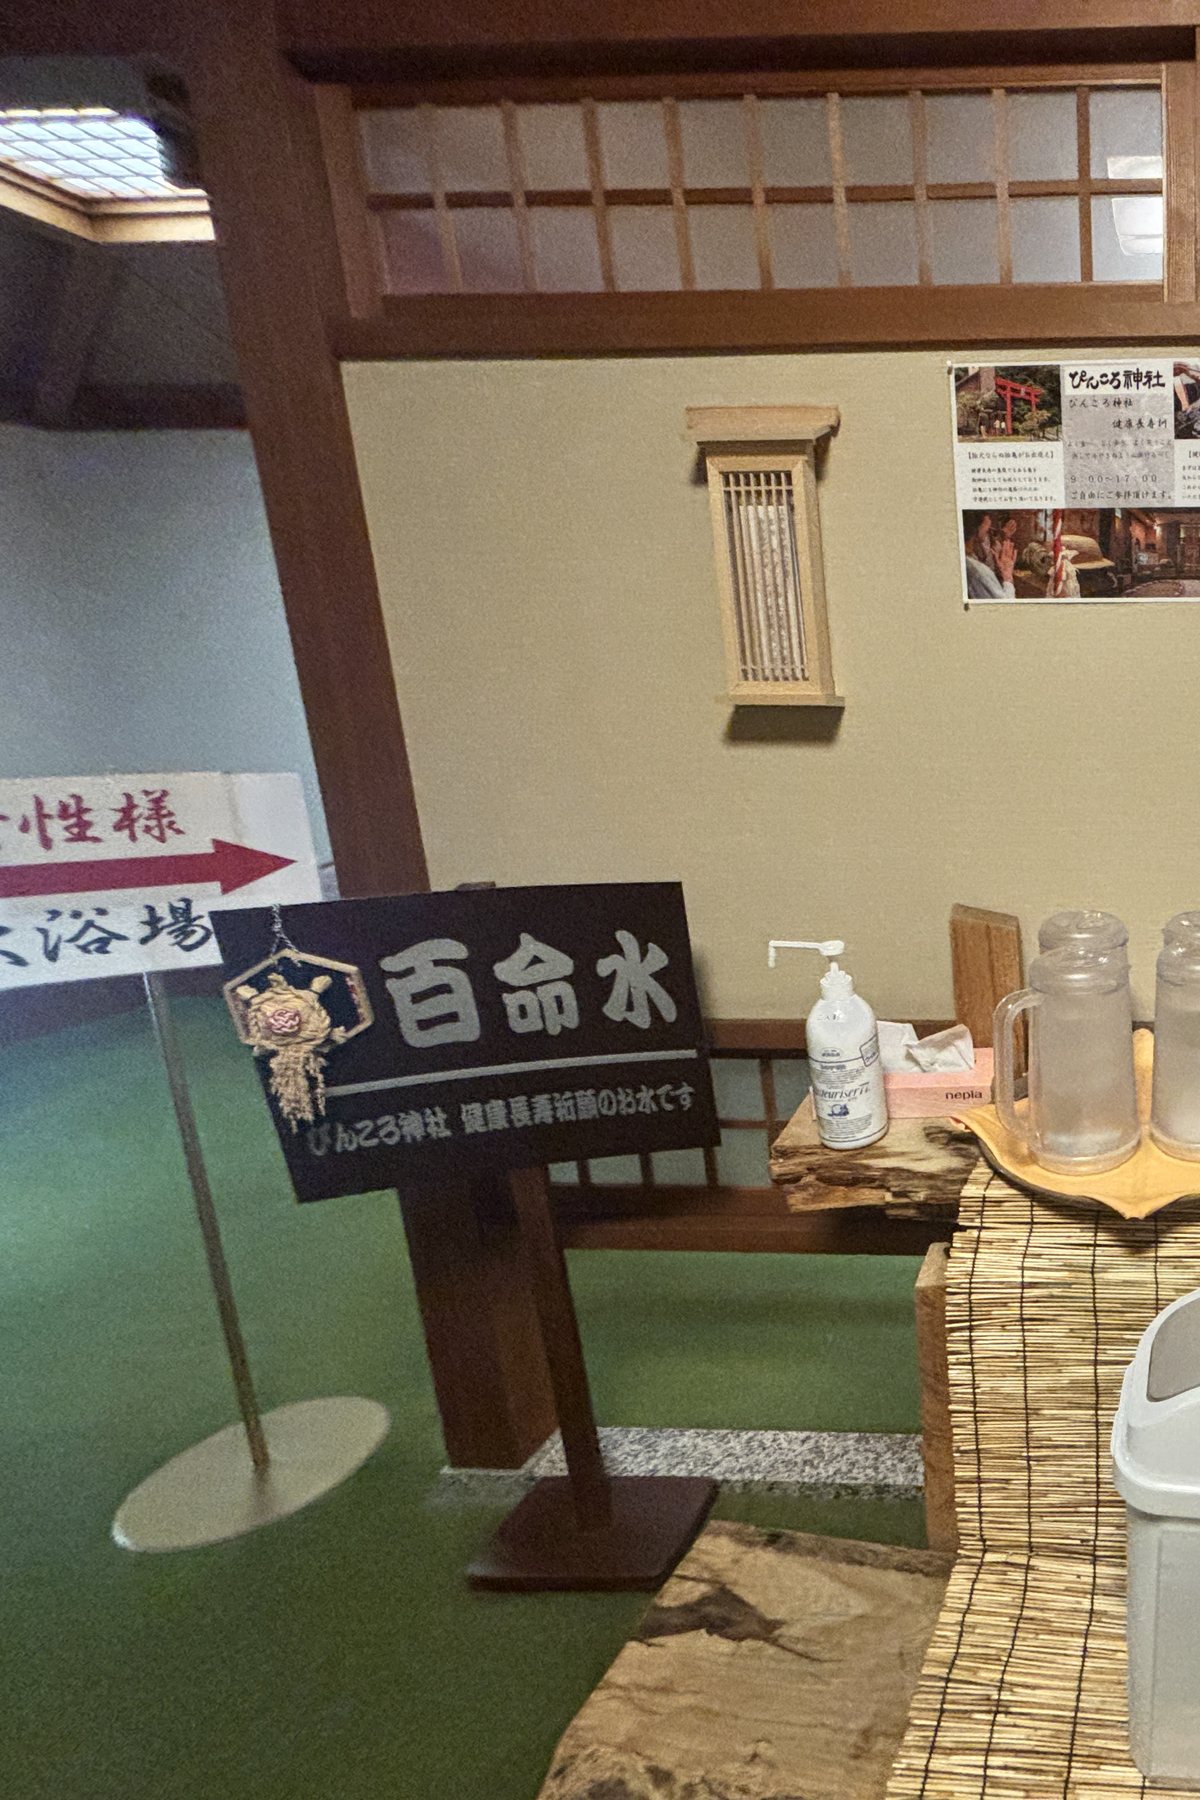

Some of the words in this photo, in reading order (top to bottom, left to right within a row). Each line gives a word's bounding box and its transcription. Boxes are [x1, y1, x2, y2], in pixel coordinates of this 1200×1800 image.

[1068, 367, 1166, 391] ぴんころ神社
[0, 788, 187, 851] 性様
[378, 929, 680, 1050] 百命水
[944, 1089, 984, 1101] nepia
